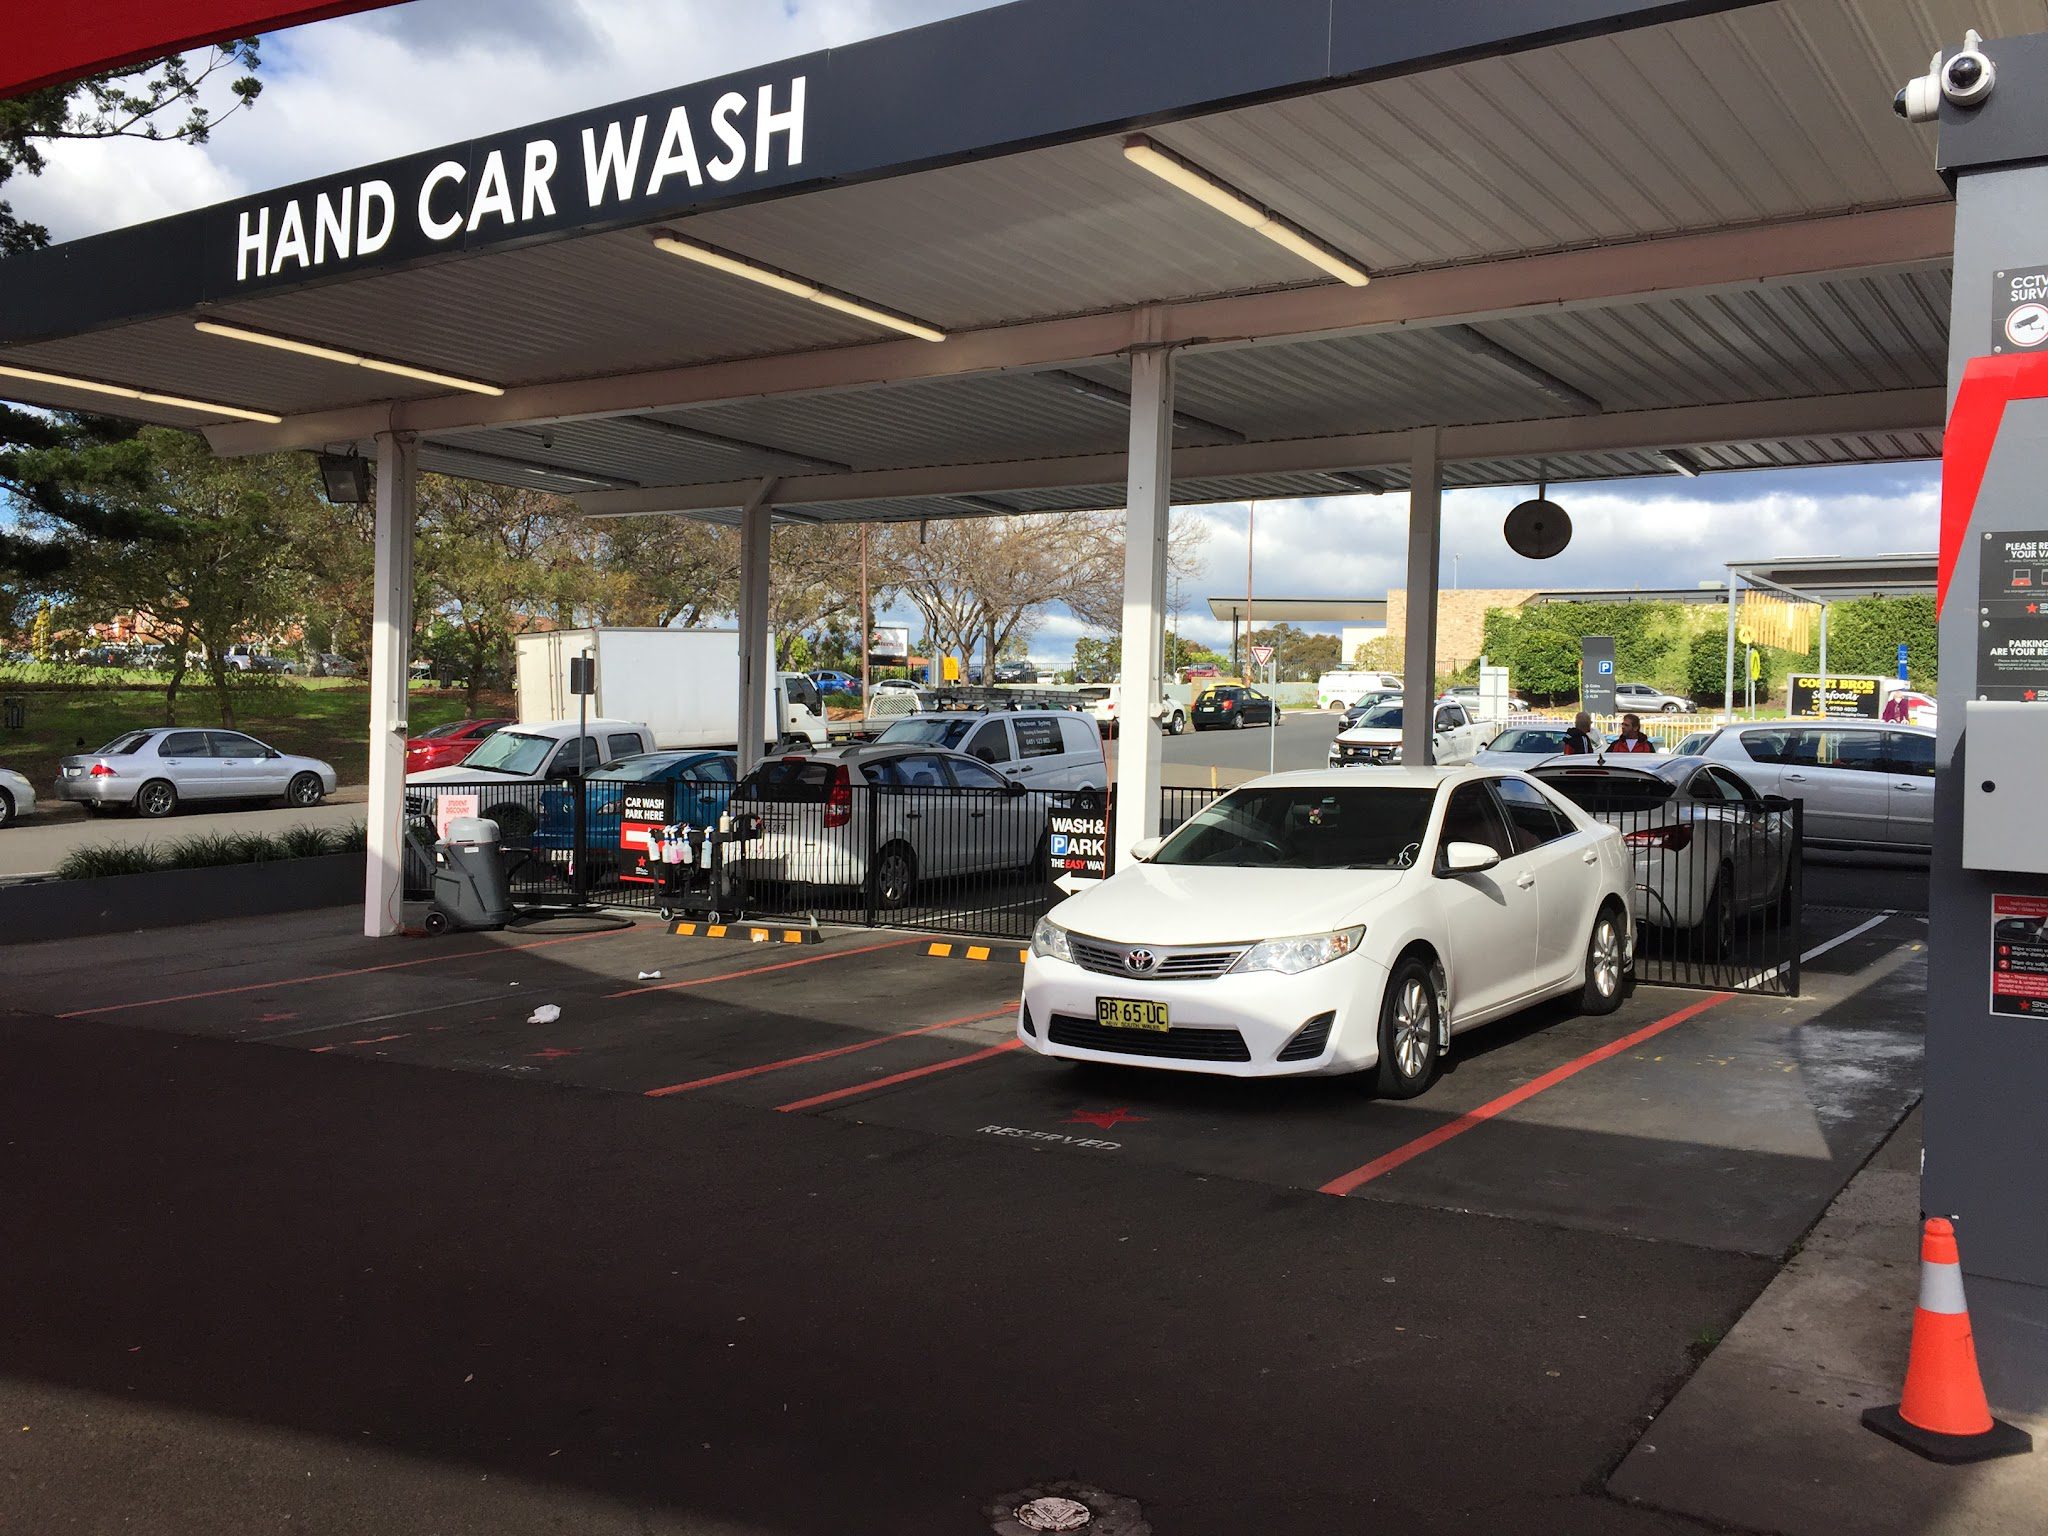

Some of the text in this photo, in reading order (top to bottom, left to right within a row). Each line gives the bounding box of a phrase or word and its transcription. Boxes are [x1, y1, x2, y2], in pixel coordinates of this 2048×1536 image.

[237, 76, 806, 281] HAND CAR WASH
[2011, 275, 2048, 288] CCTV
[2011, 287, 2048, 302] SURV
[2005, 542, 2037, 550] PLEASE
[2011, 550, 2036, 558] YOUR
[2009, 640, 2048, 648] PARKING
[1839, 680, 1874, 690] BROS
[625, 797, 664, 809] CAR WASH
[625, 809, 664, 820] PARK HERE
[1053, 837, 1105, 856] PARK
[1051, 858, 1104, 870] THE EASY WAY
[976, 1124, 1122, 1150] RESERVED
